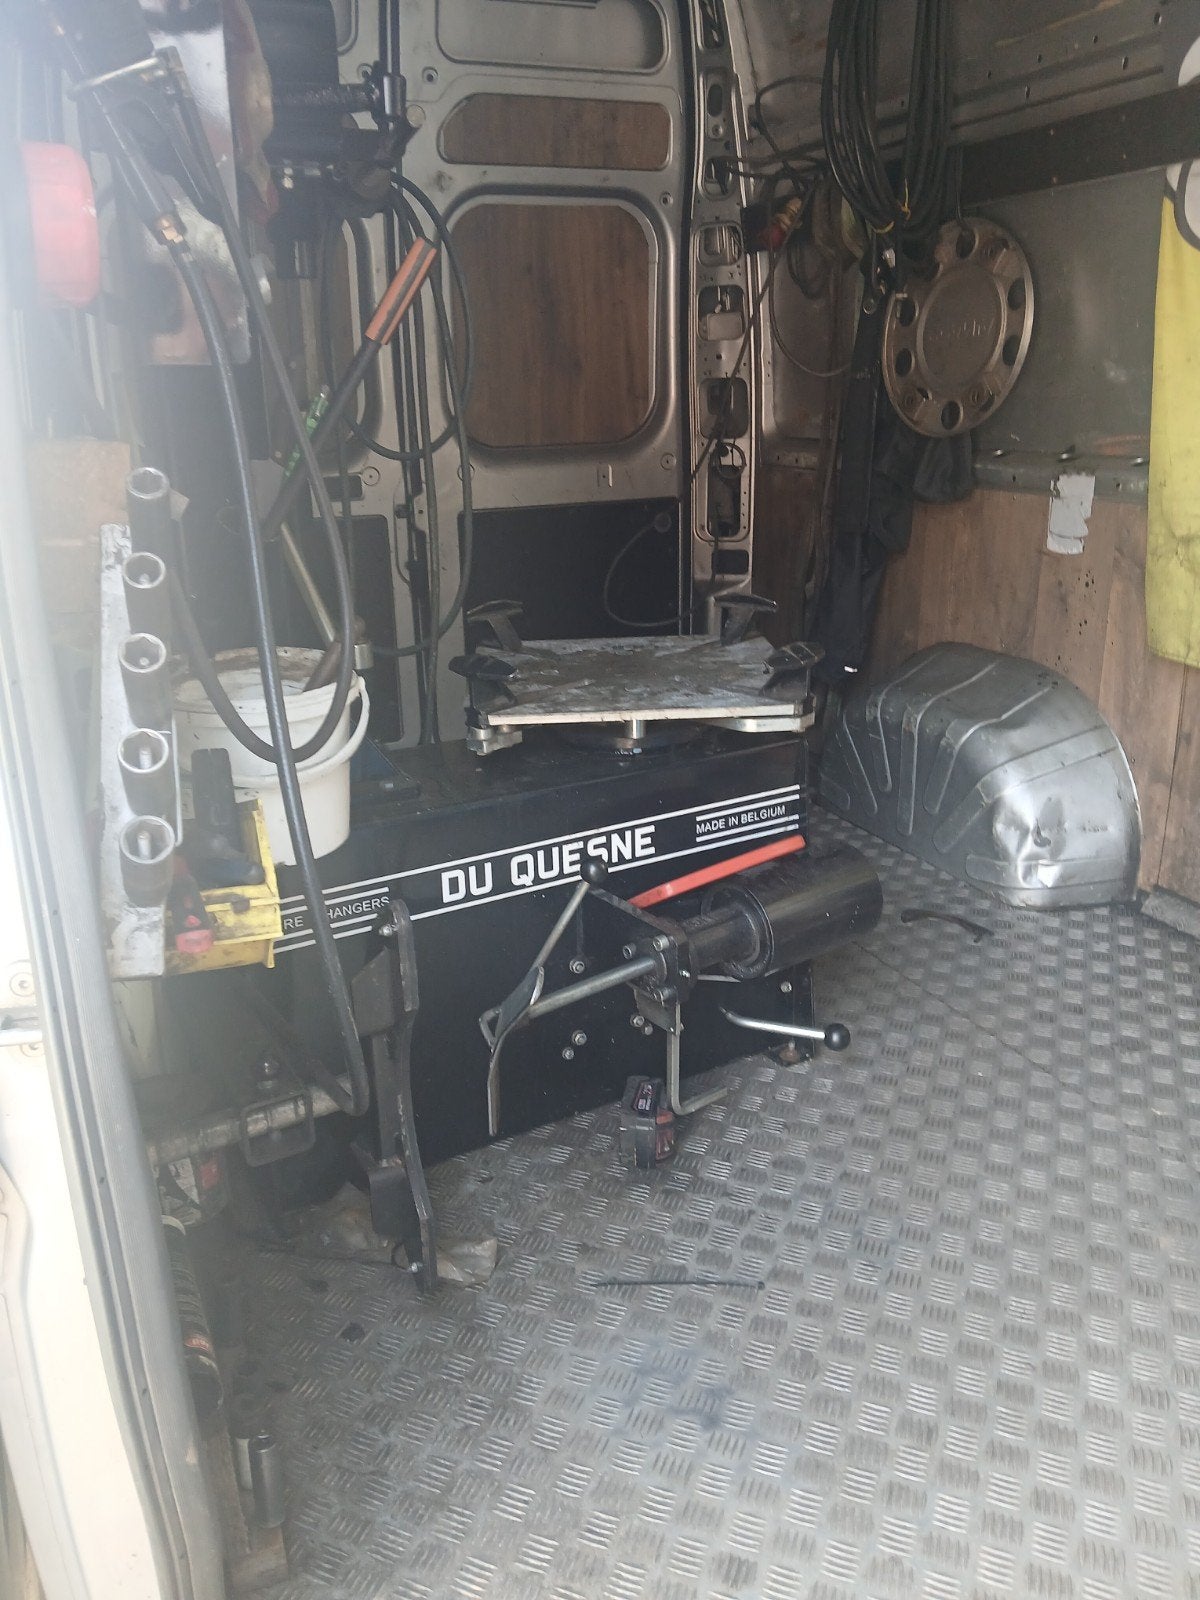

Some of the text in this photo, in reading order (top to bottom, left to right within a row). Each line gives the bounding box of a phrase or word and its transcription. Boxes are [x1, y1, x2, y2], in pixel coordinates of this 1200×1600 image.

[696, 805, 786, 834] MADE IN BELGIUM
[441, 825, 656, 903] DU QUESNE
[283, 896, 390, 930] RE HANGERS
